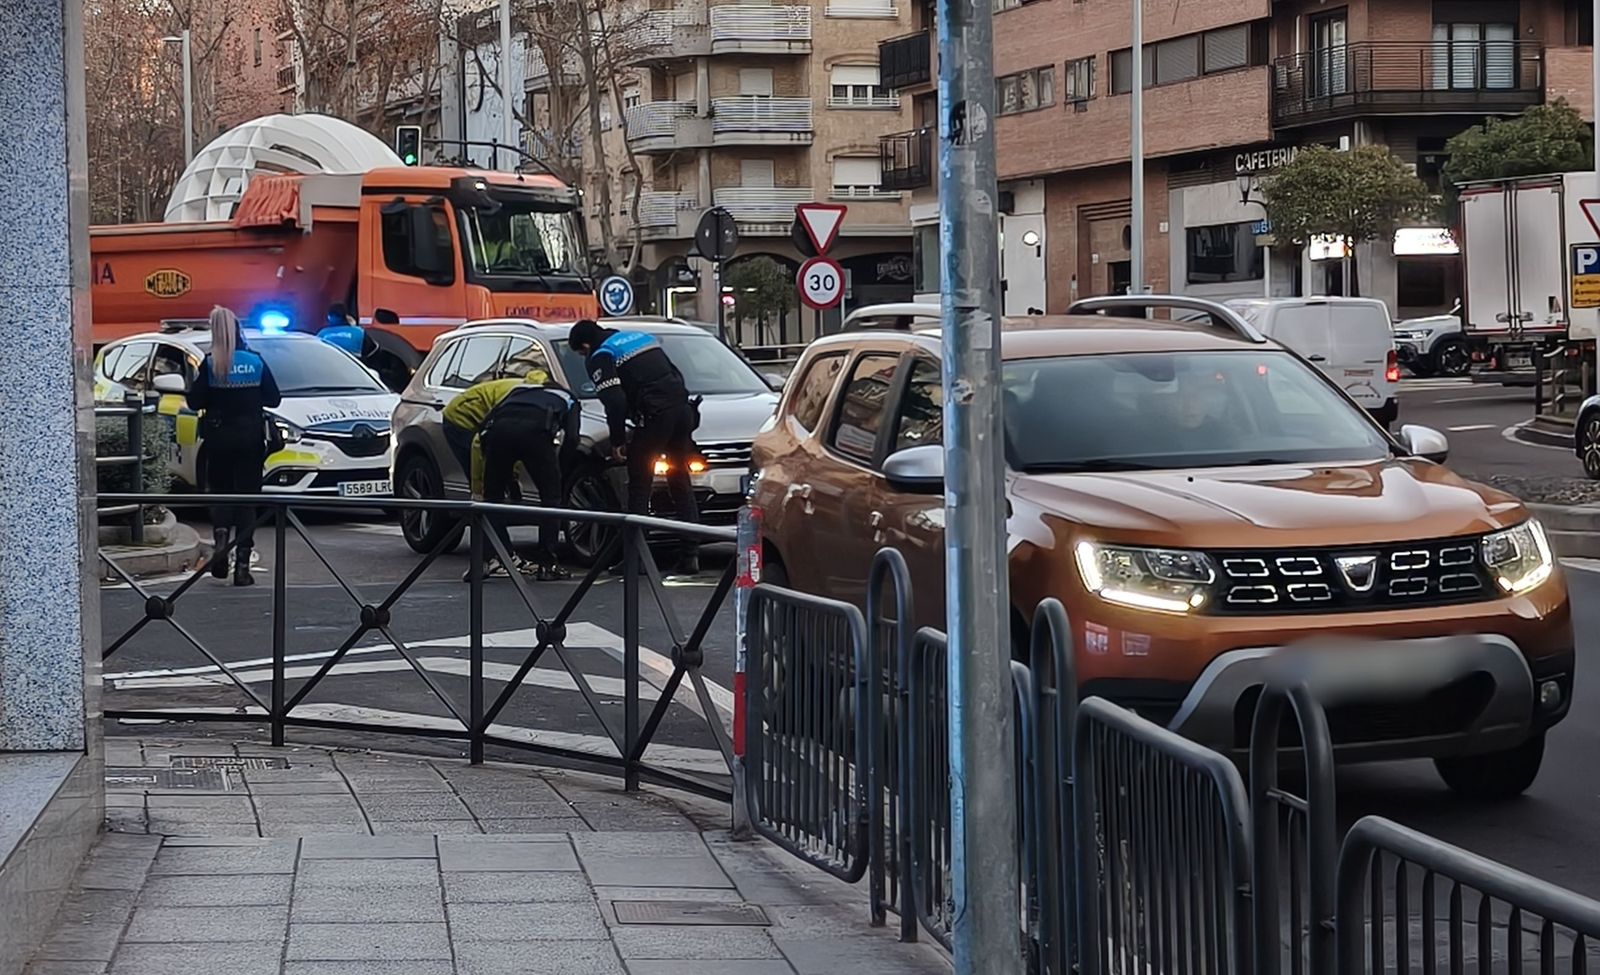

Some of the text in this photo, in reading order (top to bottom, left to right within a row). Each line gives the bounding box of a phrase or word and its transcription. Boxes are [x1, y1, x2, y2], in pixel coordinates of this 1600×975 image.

[1235, 146, 1299, 172] CAFETERIA
[1577, 248, 1598, 274] P
[810, 274, 834, 291] 30
[230, 364, 256, 374] ICIA
